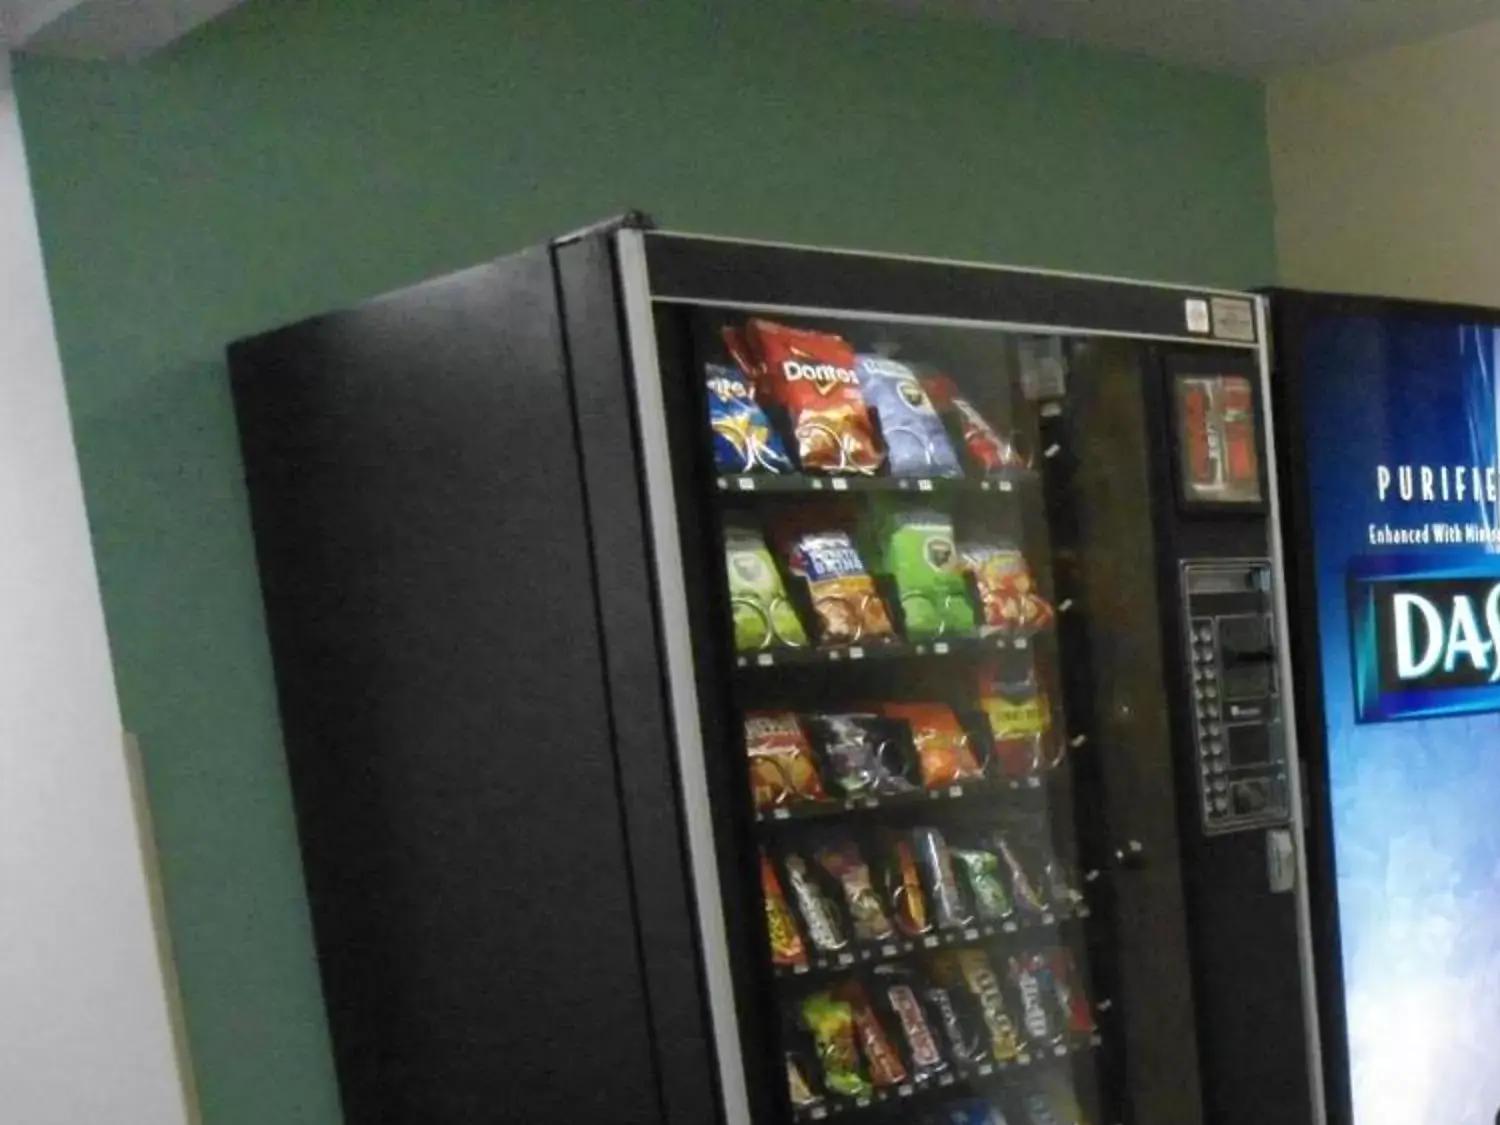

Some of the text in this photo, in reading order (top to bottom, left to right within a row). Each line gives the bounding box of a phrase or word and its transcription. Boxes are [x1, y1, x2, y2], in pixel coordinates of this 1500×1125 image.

[782, 360, 860, 385] Doritos
[1368, 522, 1429, 545] Enhanced
[1431, 522, 1463, 544] With
